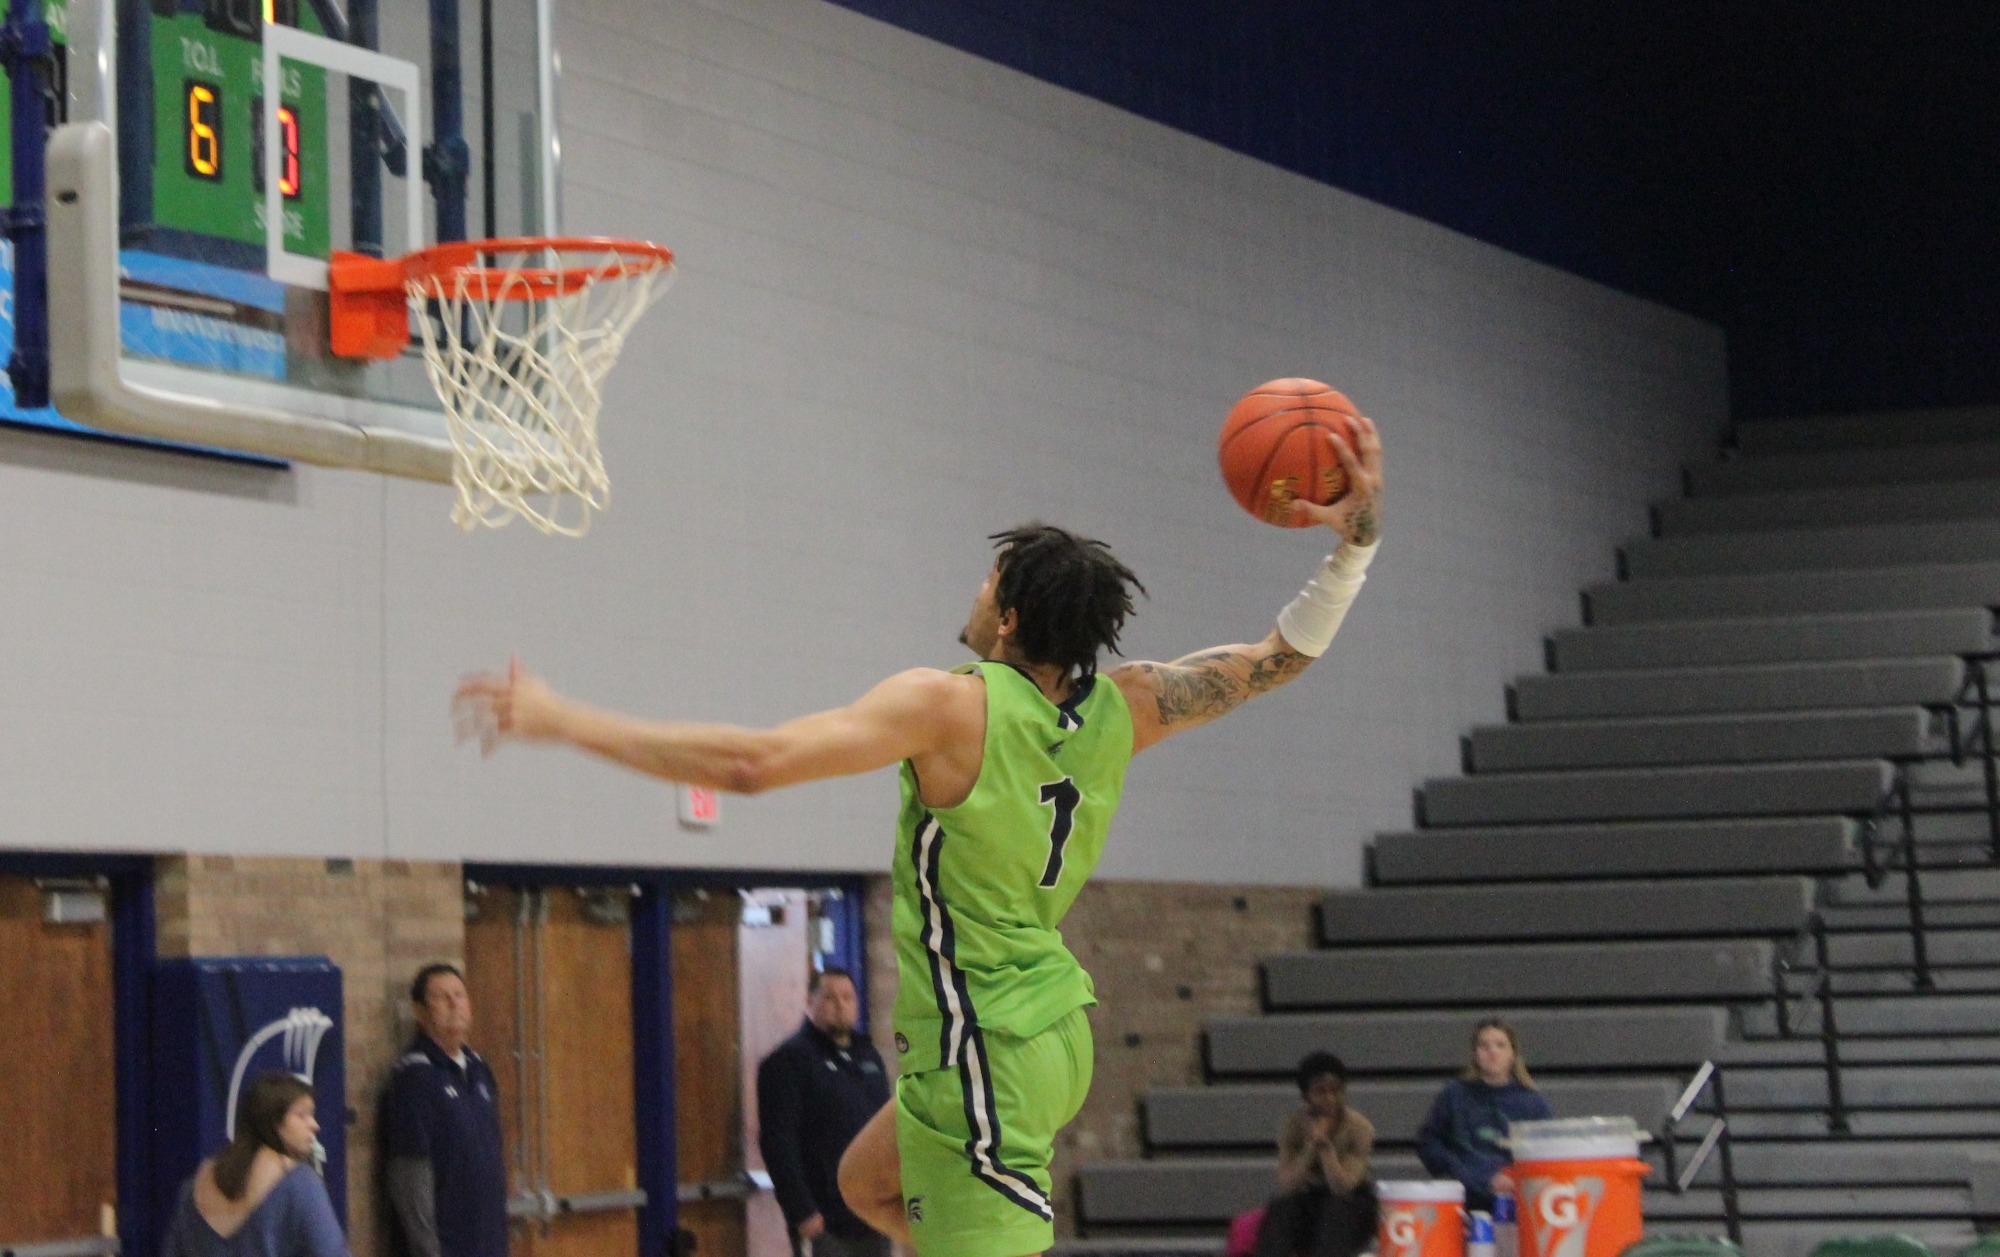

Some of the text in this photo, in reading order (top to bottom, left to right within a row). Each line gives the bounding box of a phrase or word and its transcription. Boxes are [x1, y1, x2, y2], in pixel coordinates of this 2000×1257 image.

[189, 85, 218, 175] 6
[1037, 776, 1082, 889] 1
[1387, 1212, 1417, 1245] G
[1540, 1184, 1580, 1227] G
